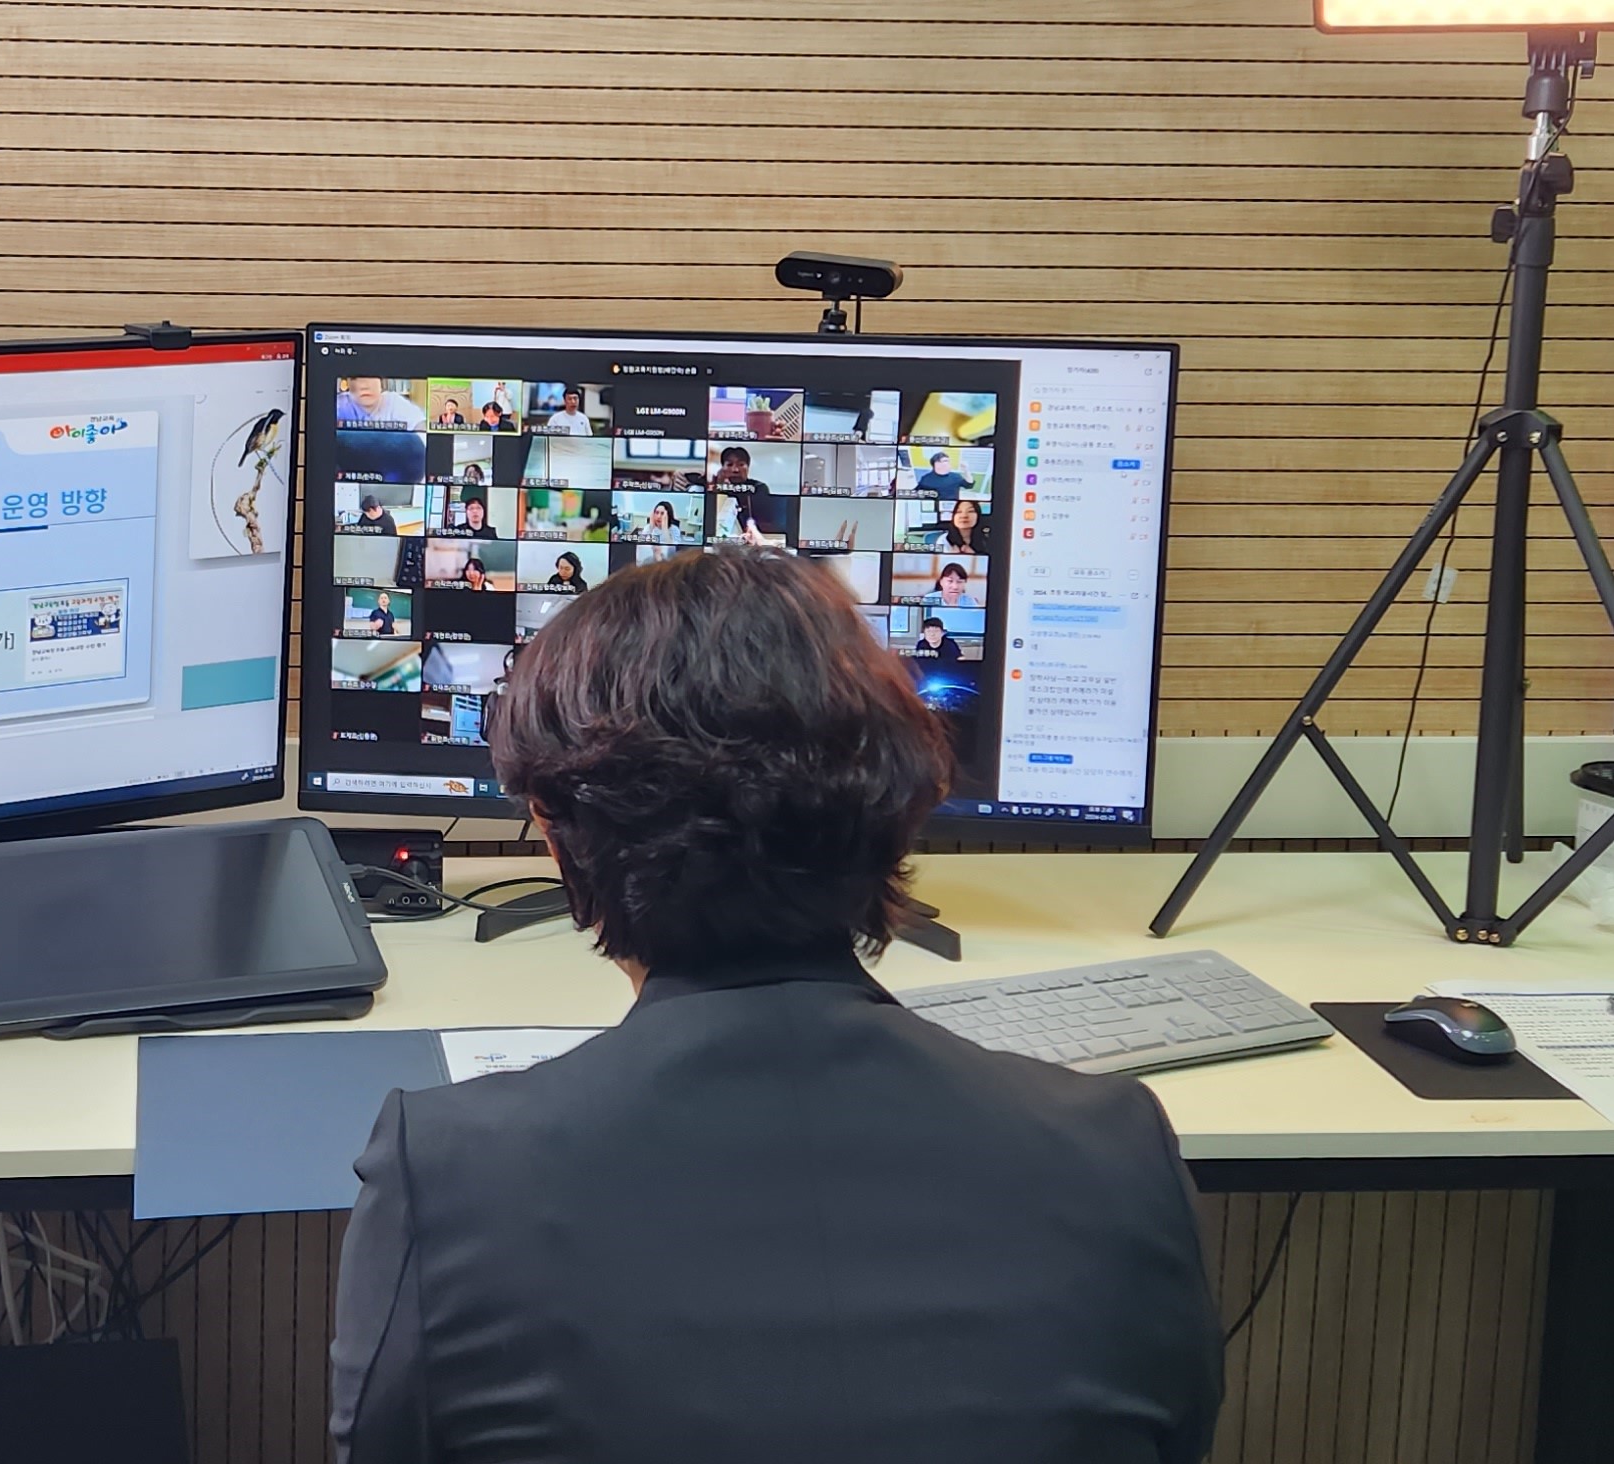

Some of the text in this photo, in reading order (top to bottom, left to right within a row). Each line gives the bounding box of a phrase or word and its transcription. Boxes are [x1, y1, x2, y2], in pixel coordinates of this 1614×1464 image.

[49, 420, 129, 445] 아이좋아
[2, 492, 49, 520] 운영
[61, 488, 107, 516] 방향
